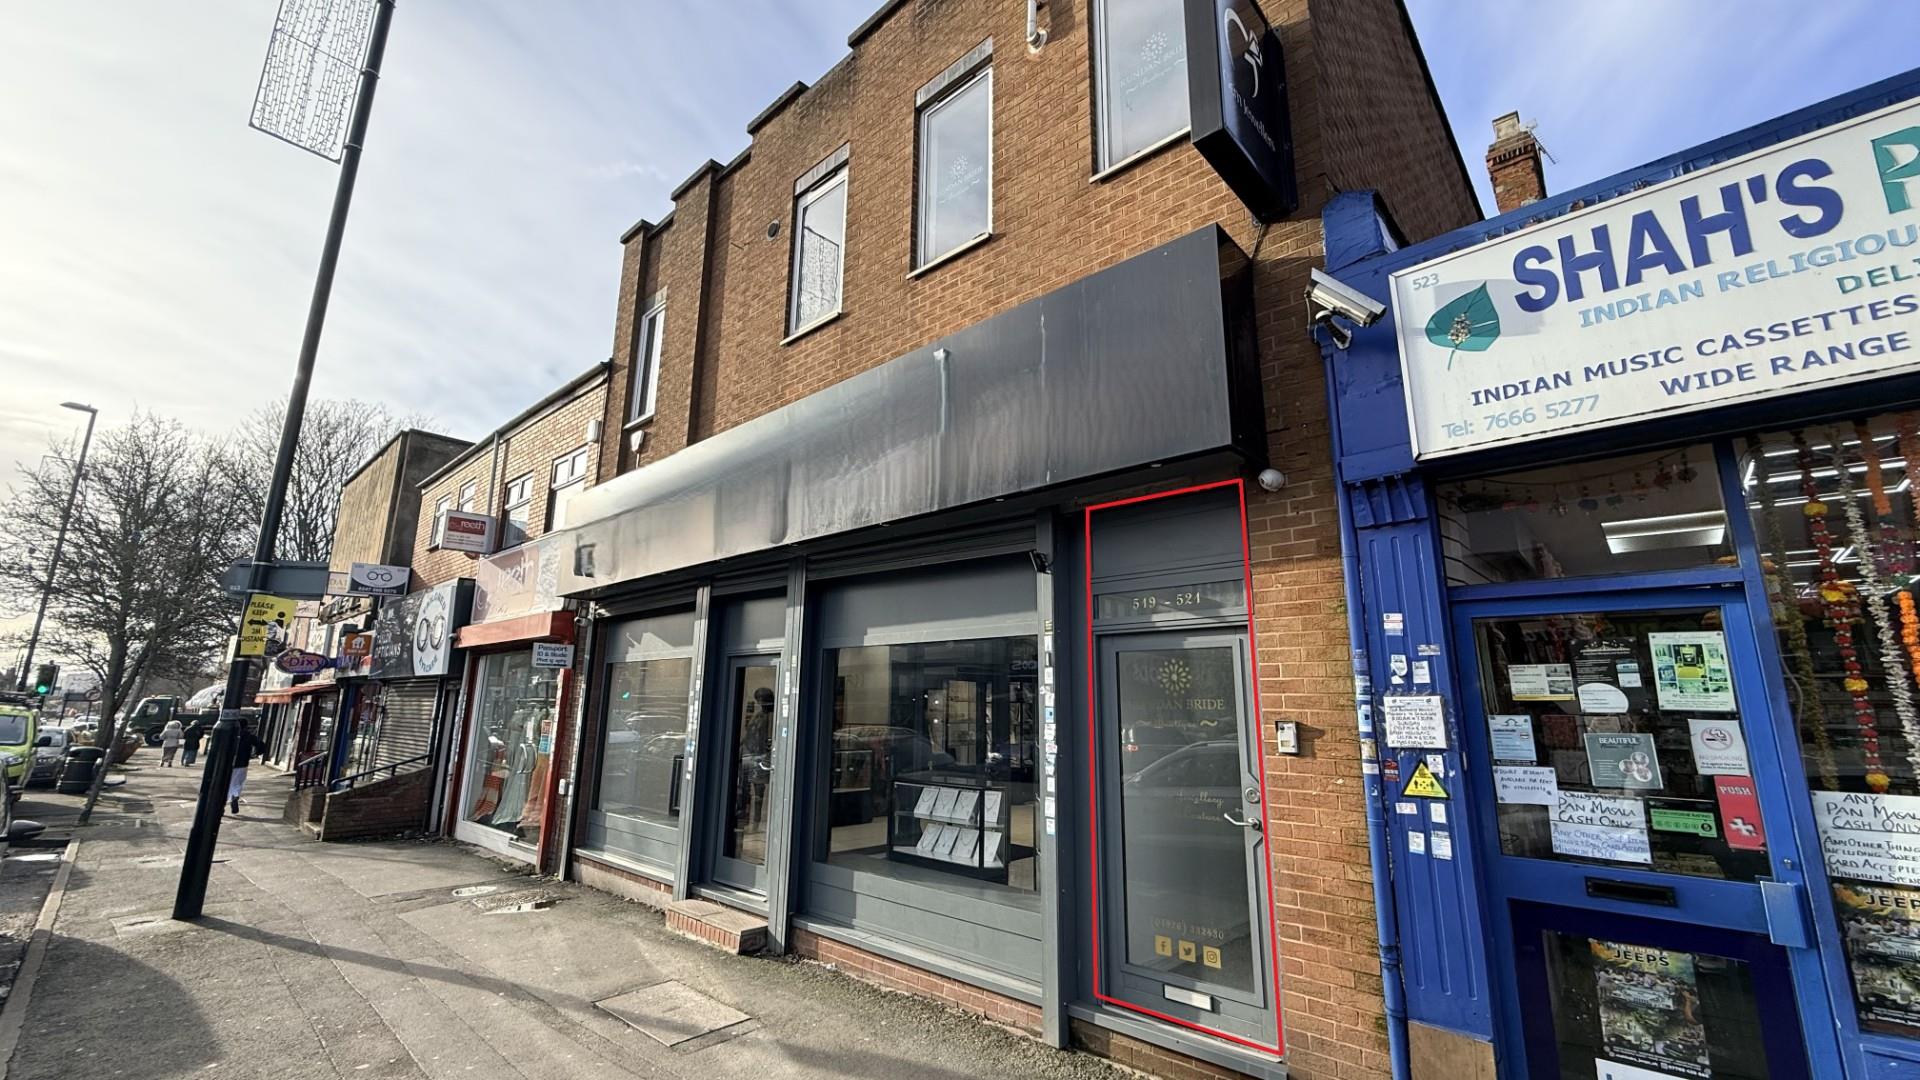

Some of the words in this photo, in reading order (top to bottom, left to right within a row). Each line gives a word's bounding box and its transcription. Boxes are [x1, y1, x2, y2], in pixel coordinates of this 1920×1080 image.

[1513, 157, 1845, 312] SHAH'S
[1412, 273, 1440, 292] 523
[1578, 279, 1705, 328] INDIAN
[1471, 369, 1572, 406] INDIAN
[1583, 345, 1684, 383] MUSIC
[1695, 294, 1919, 357] CASSETTES
[1660, 361, 1756, 397] WIDE
[1770, 331, 1910, 377] RANGE
[1442, 420, 1475, 440] Tel:
[1484, 406, 1536, 433] 7666
[1545, 394, 1600, 421] 5277
[250, 602, 275, 610] PLEASE
[1132, 596, 1156, 610] 519
[1176, 591, 1201, 606] 521
[1186, 698, 1226, 710] BRIDE
[1598, 737, 1639, 745] BEAUTIFUL
[1719, 784, 1752, 795] PUSH
[1558, 796, 1585, 812] PAN
[1843, 794, 1879, 805] ANY
[1826, 802, 1863, 818] PAN
[1558, 810, 1593, 824] CASH
[1599, 815, 1633, 828] ONLY
[1832, 815, 1872, 830] CASH
[1848, 838, 1884, 849] OTHER
[1828, 855, 1859, 868] CARD
[1886, 851, 1920, 862] SWEE
[1614, 950, 1669, 966] JEEPS
